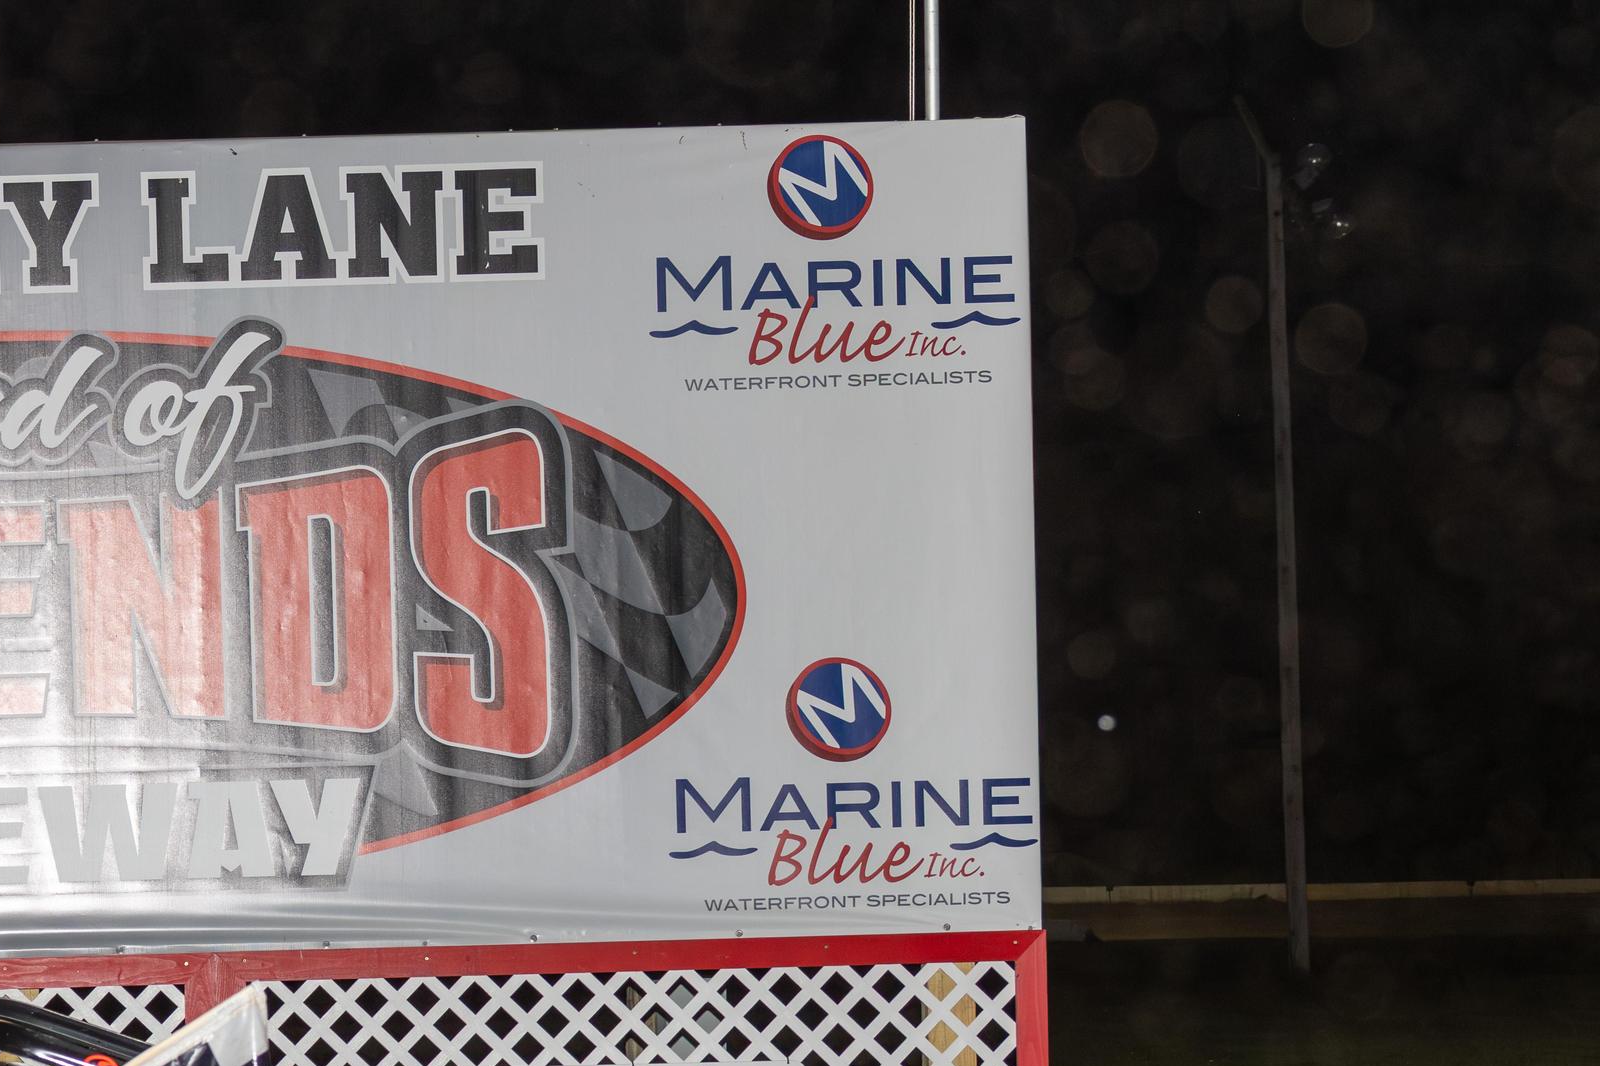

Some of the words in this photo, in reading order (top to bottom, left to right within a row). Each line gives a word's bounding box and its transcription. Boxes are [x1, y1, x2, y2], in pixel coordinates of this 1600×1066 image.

[144, 165, 543, 288] LANE
[656, 255, 1015, 312] MARINE
[748, 296, 905, 365] Blue
[905, 330, 967, 358] Inc.
[684, 374, 842, 392] WATERFRONT
[847, 370, 993, 388] SPECIALISTS
[123, 331, 272, 500] of
[675, 777, 1033, 834] MARINE
[767, 816, 924, 886] Blue
[924, 851, 985, 878] Inc.
[704, 895, 862, 912] WATERFRONT
[867, 891, 1011, 908] SPECIALISTS
